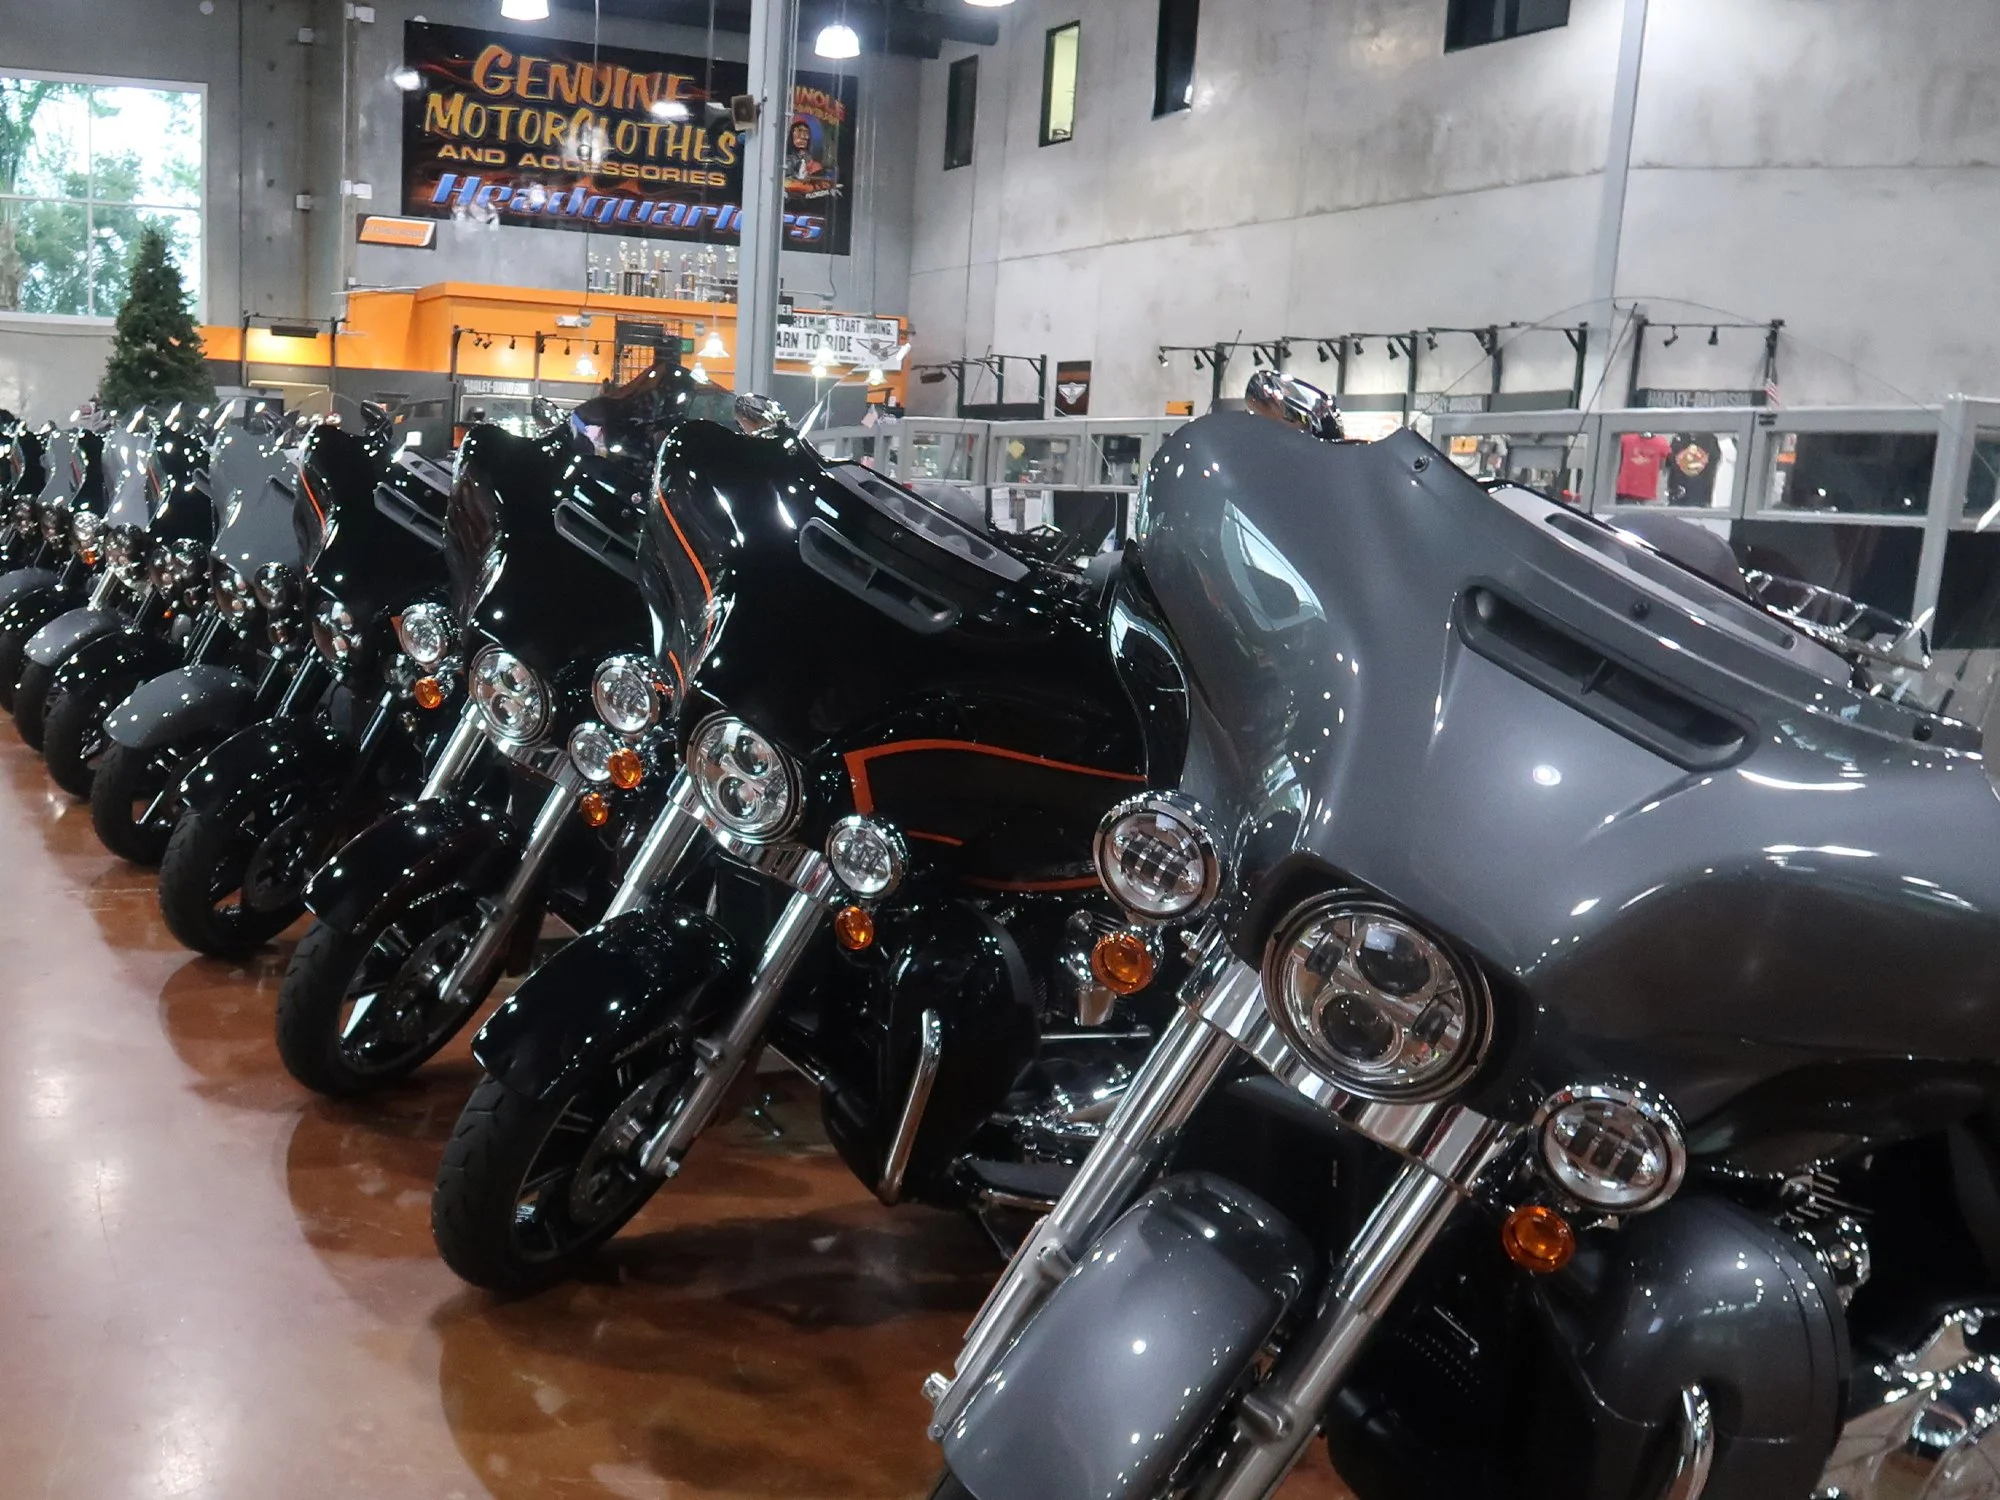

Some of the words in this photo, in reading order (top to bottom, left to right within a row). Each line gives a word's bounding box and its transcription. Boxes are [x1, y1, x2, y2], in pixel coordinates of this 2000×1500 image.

[473, 45, 694, 112] GENUINE
[425, 93, 736, 165] MOTORCLOTHES
[438, 144, 506, 164] AND
[518, 153, 727, 187] ACCESSORIES
[432, 173, 825, 240] Headquarts
[776, 331, 800, 349] ARN
[806, 333, 820, 350] TO
[826, 335, 853, 353] RIDE
[836, 319, 861, 334] START
